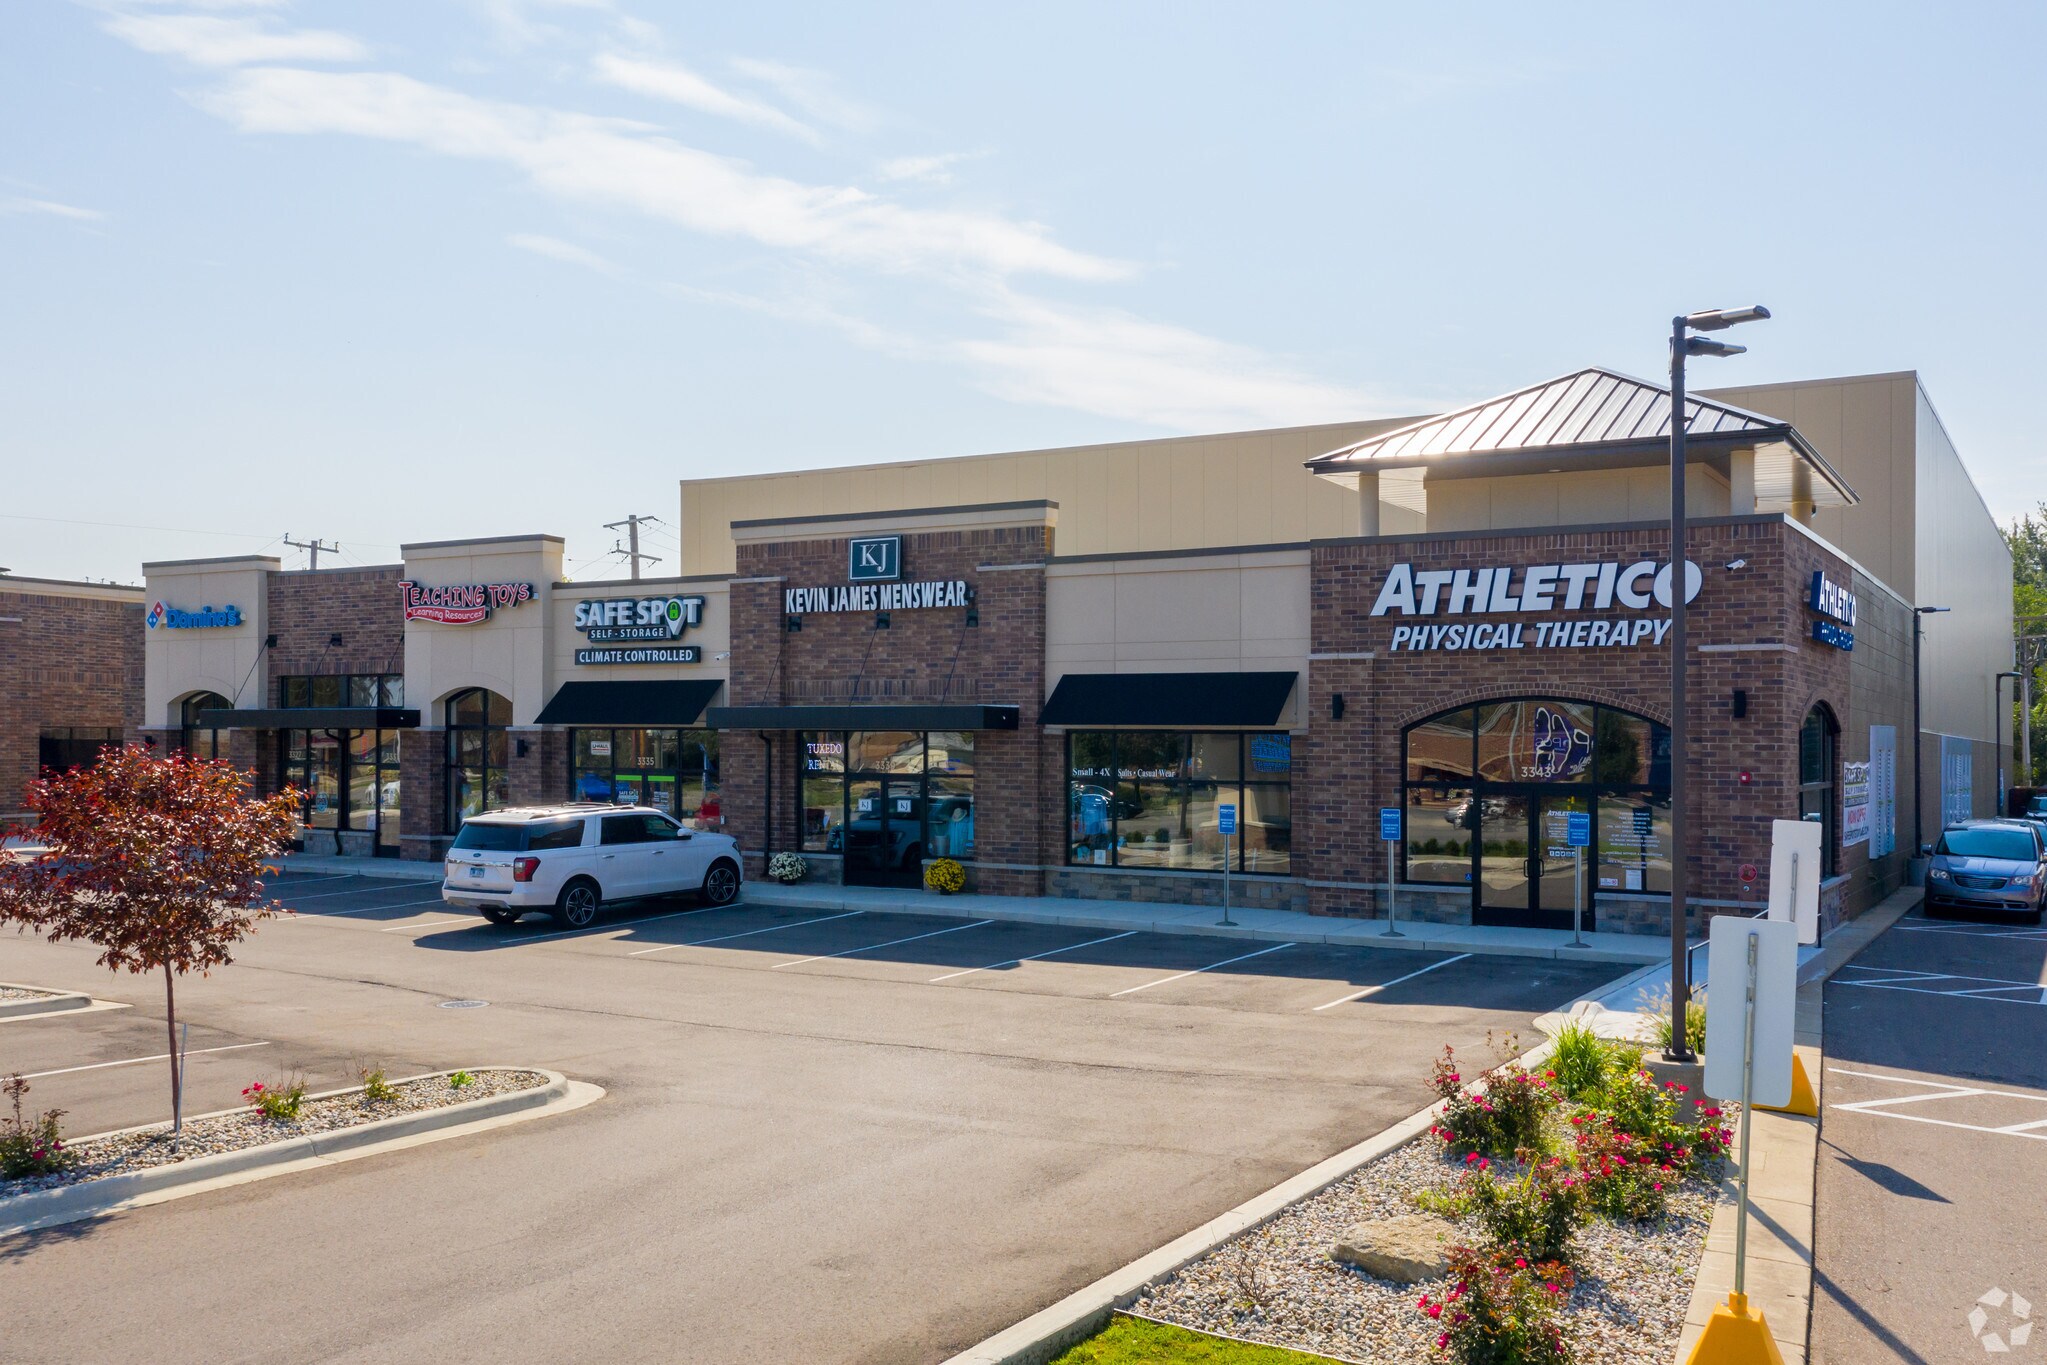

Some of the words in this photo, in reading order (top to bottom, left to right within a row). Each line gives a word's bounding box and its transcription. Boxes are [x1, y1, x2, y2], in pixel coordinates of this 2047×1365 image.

[859, 543, 889, 573] KJ
[1370, 559, 1703, 616] ATHLETICO
[398, 581, 485, 610] TEACHING
[489, 583, 530, 608] TOYS
[785, 587, 829, 613] KEVIN
[831, 585, 877, 612] JAMES
[880, 580, 966, 610] MENSWEAR
[166, 604, 241, 629] Domino's
[412, 609, 443, 621] Learning
[444, 609, 483, 620] Resources
[574, 601, 634, 627] SAFE
[636, 598, 702, 635] SPOT
[590, 628, 612, 639] SELF
[620, 627, 664, 638] STORAGE
[1390, 623, 1525, 651] PHYSICAL
[1535, 619, 1672, 648] THERAPY
[579, 651, 622, 662] CLIMATE
[624, 649, 693, 662] CONTROLLED
[807, 743, 843, 754] TUXEDO
[637, 756, 655, 766] 3335
[1072, 767, 1094, 776] Small
[1099, 767, 1111, 777] 4X
[1137, 768, 1158, 778] Casual
[1520, 766, 1552, 778] 3343
